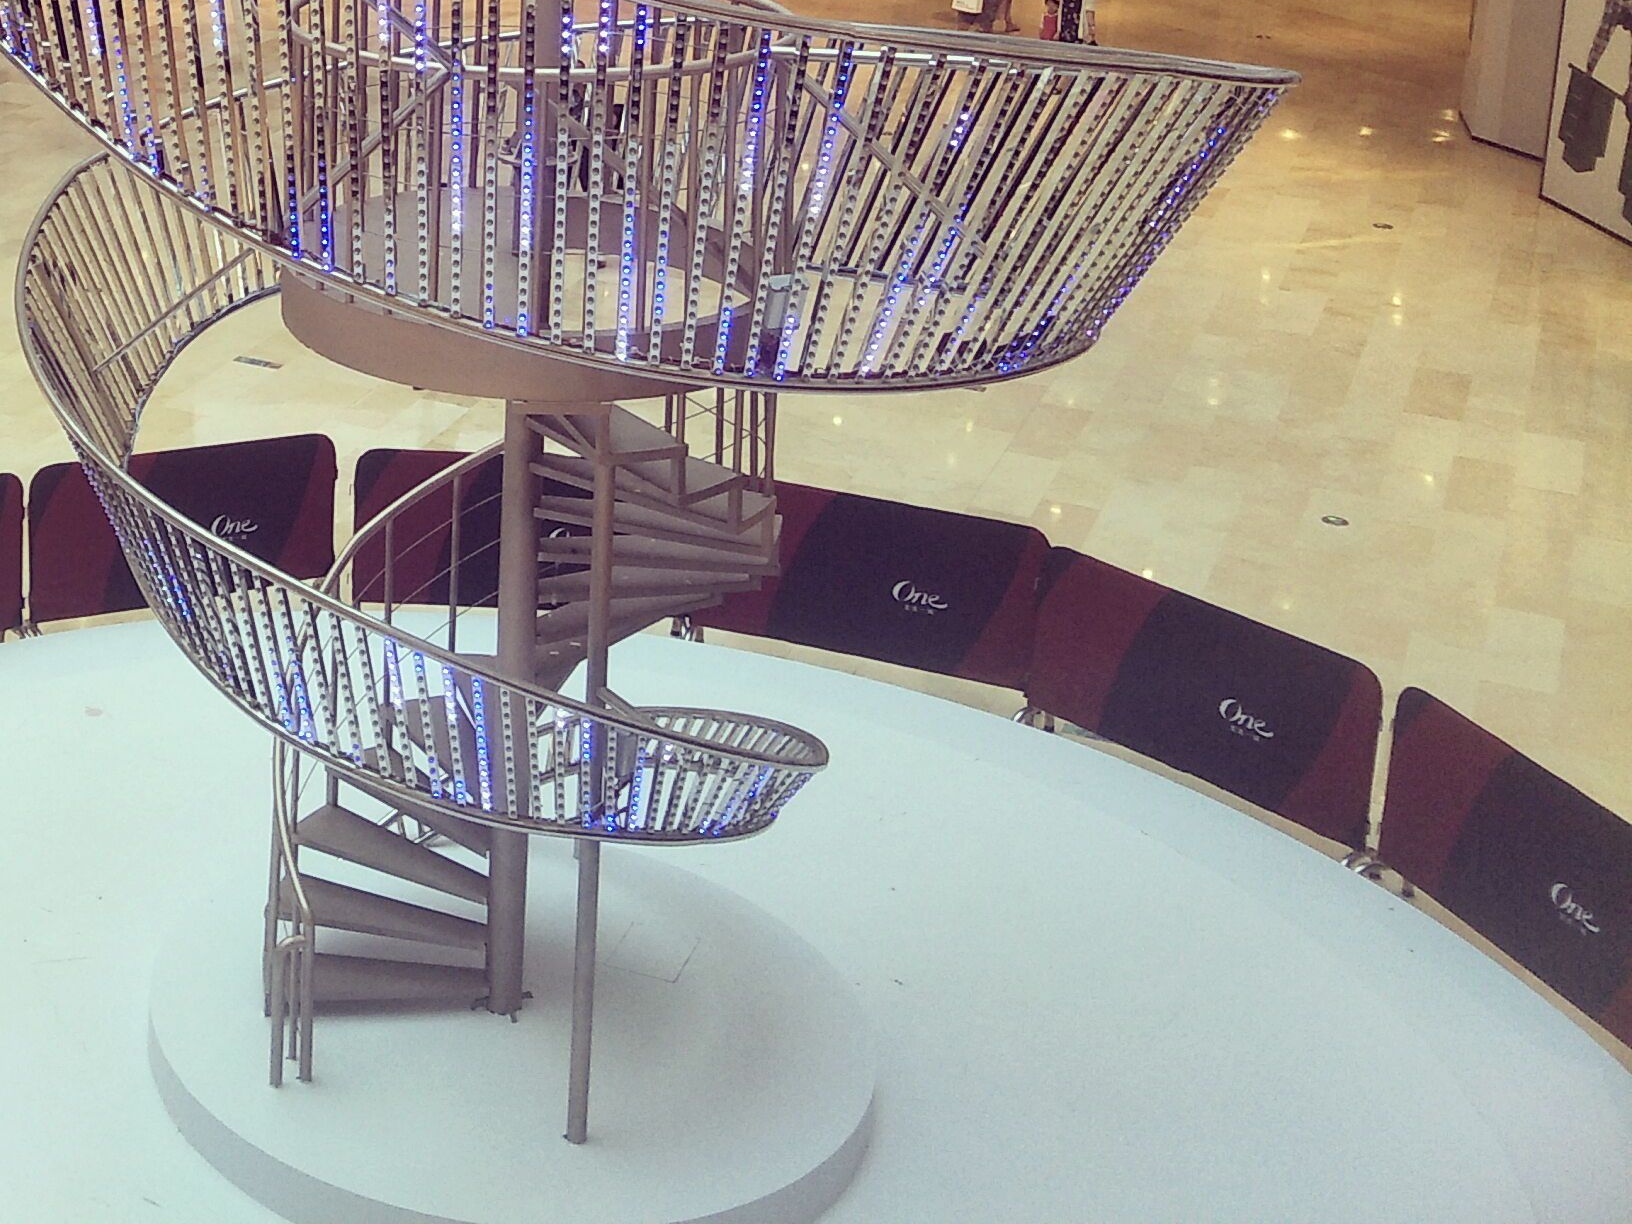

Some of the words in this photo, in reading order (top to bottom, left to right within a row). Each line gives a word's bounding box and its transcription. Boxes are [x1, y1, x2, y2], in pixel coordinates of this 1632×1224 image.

[210, 514, 258, 536] One
[891, 580, 949, 610] One
[1218, 698, 1275, 738] One
[1551, 882, 1601, 933] One
